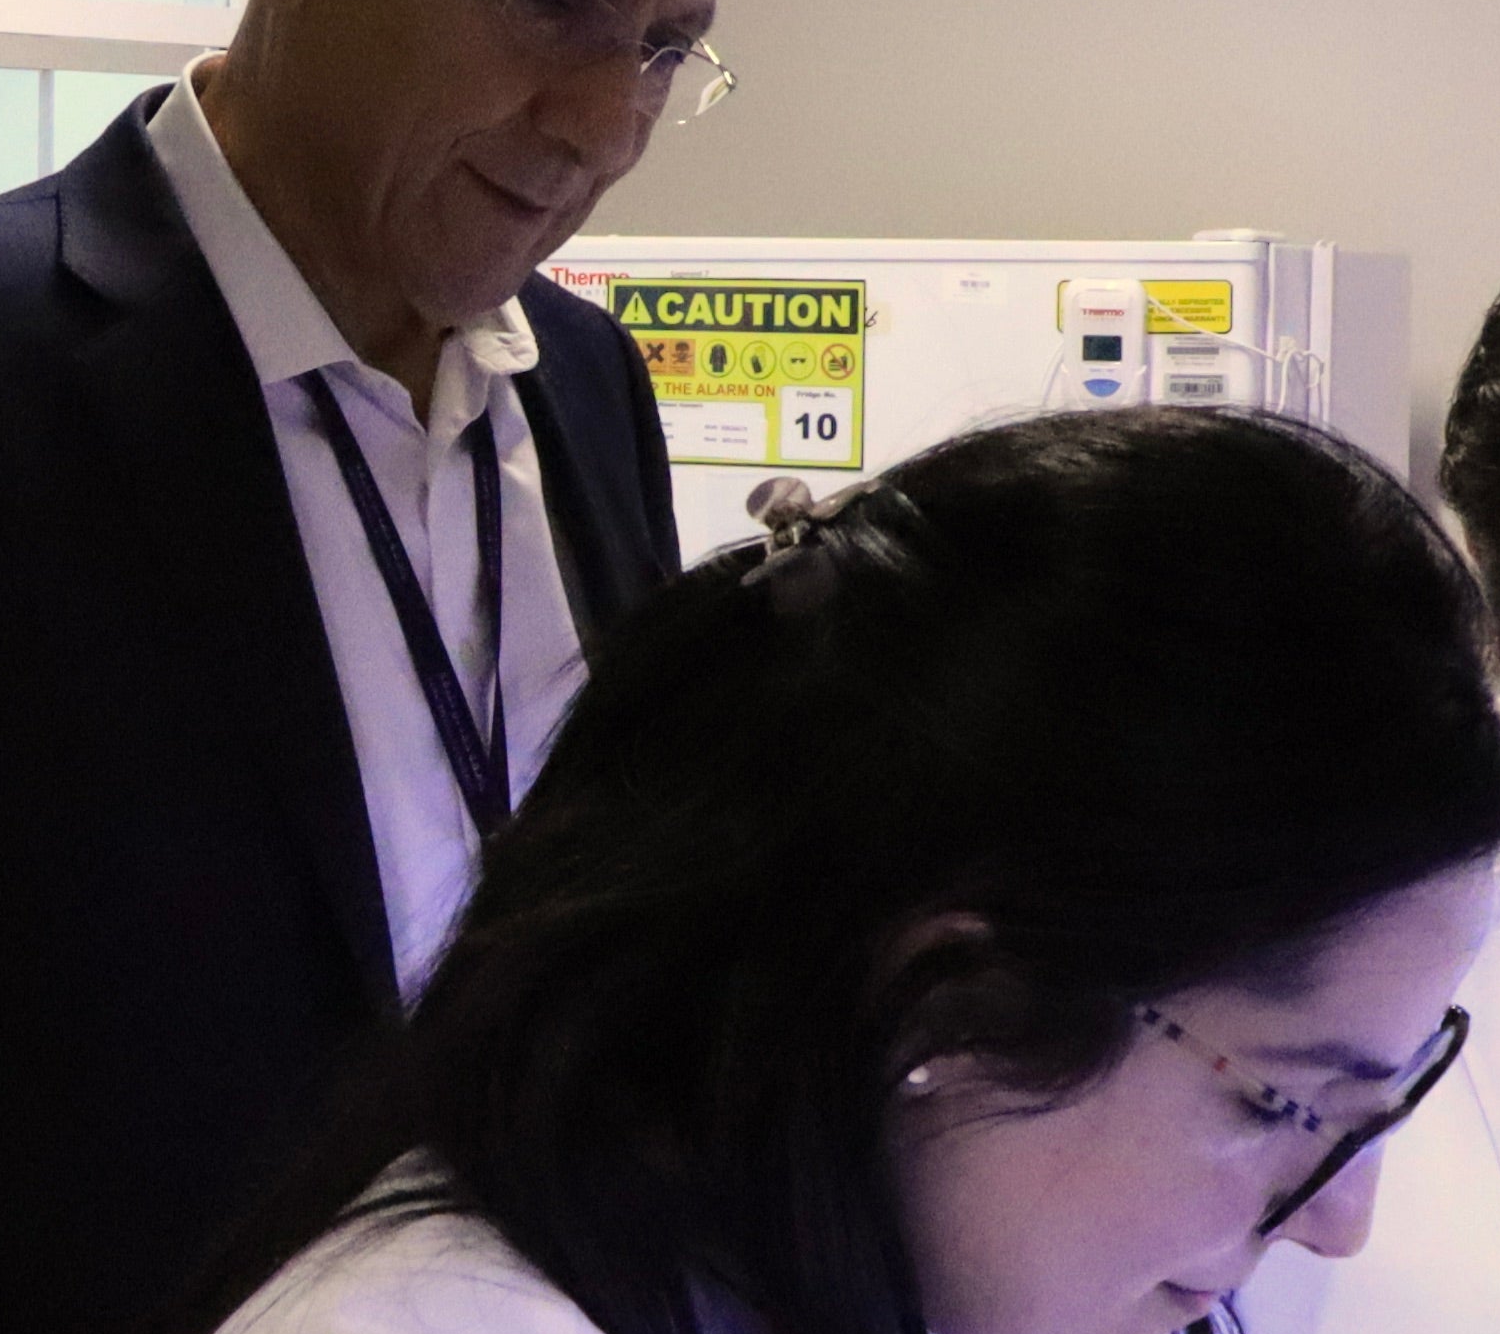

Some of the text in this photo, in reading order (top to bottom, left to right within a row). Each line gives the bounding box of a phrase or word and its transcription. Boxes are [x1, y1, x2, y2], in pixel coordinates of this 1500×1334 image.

[656, 291, 851, 329] CAUTION
[664, 382, 692, 396] THE
[696, 383, 749, 397] ALARM
[754, 384, 775, 398] ON
[794, 412, 838, 441] 10
